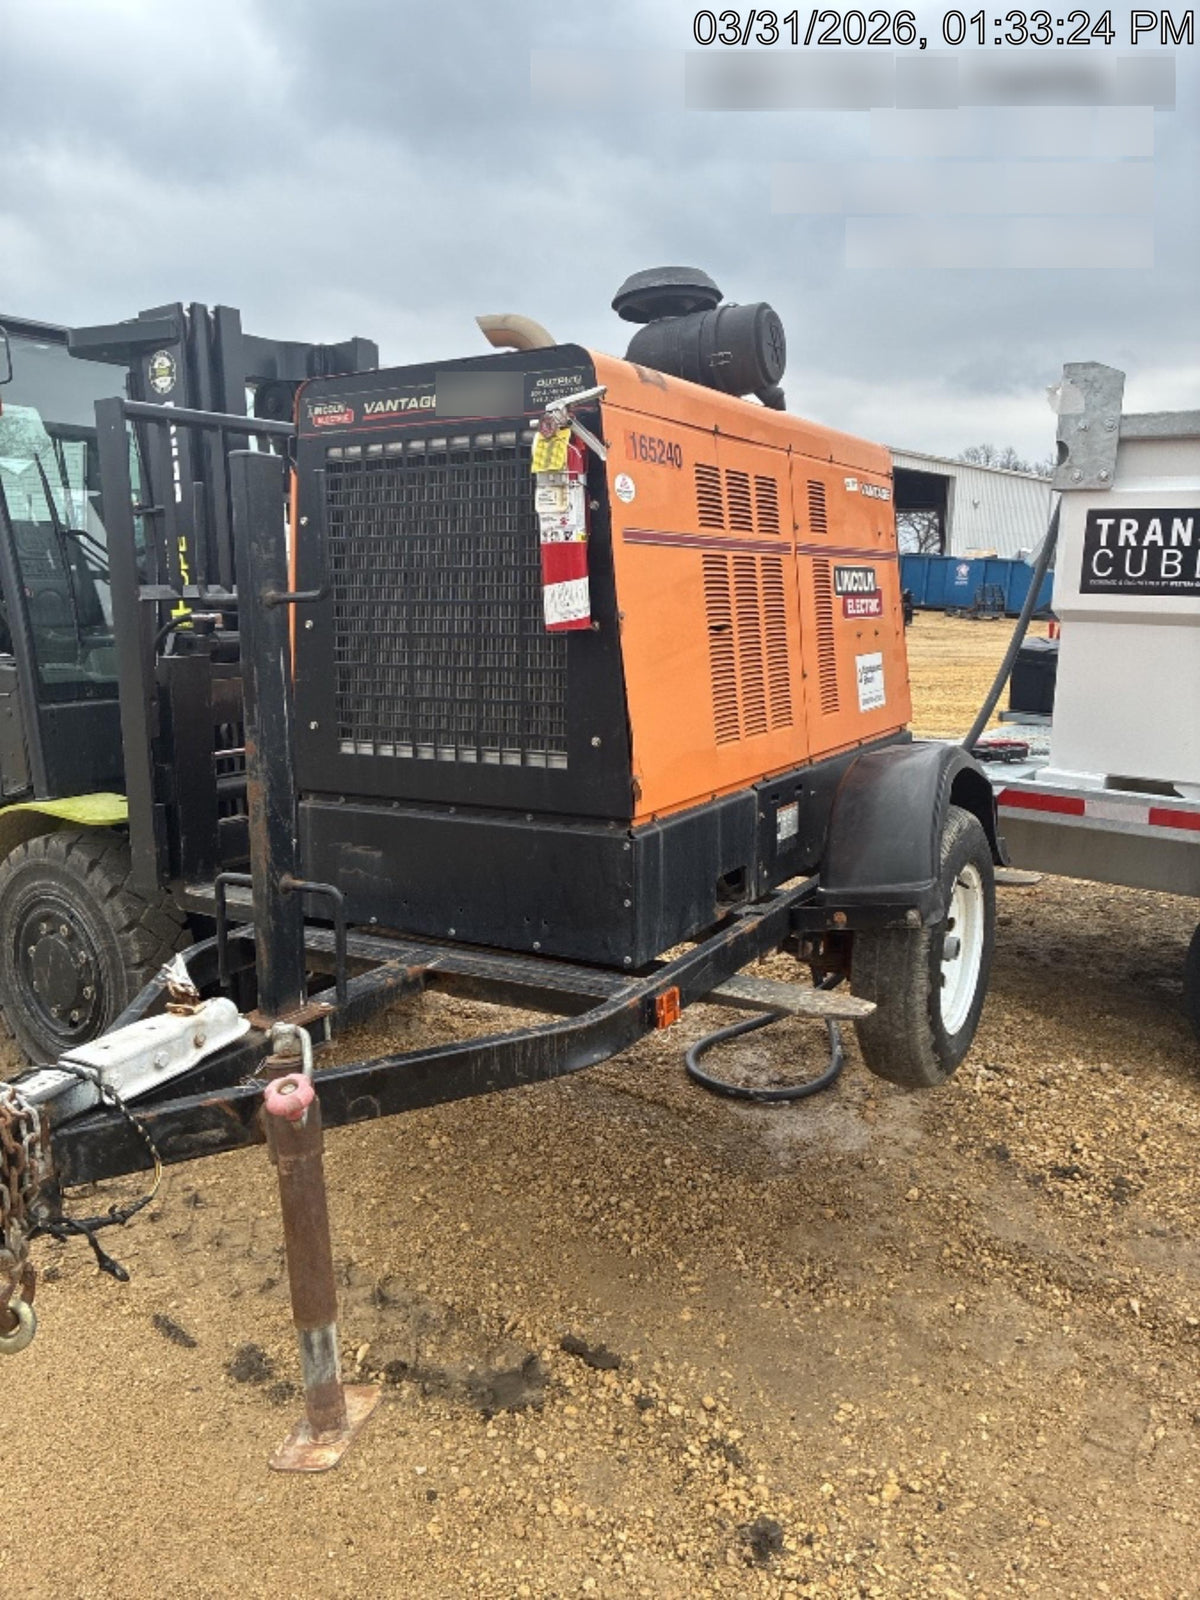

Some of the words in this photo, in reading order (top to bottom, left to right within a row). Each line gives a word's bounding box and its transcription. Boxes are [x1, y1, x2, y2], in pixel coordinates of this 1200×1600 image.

[629, 431, 682, 469] 165240
[1096, 517, 1200, 547] TRAN
[835, 569, 876, 591] LINCOLN
[847, 598, 880, 614] ELECTRIC
